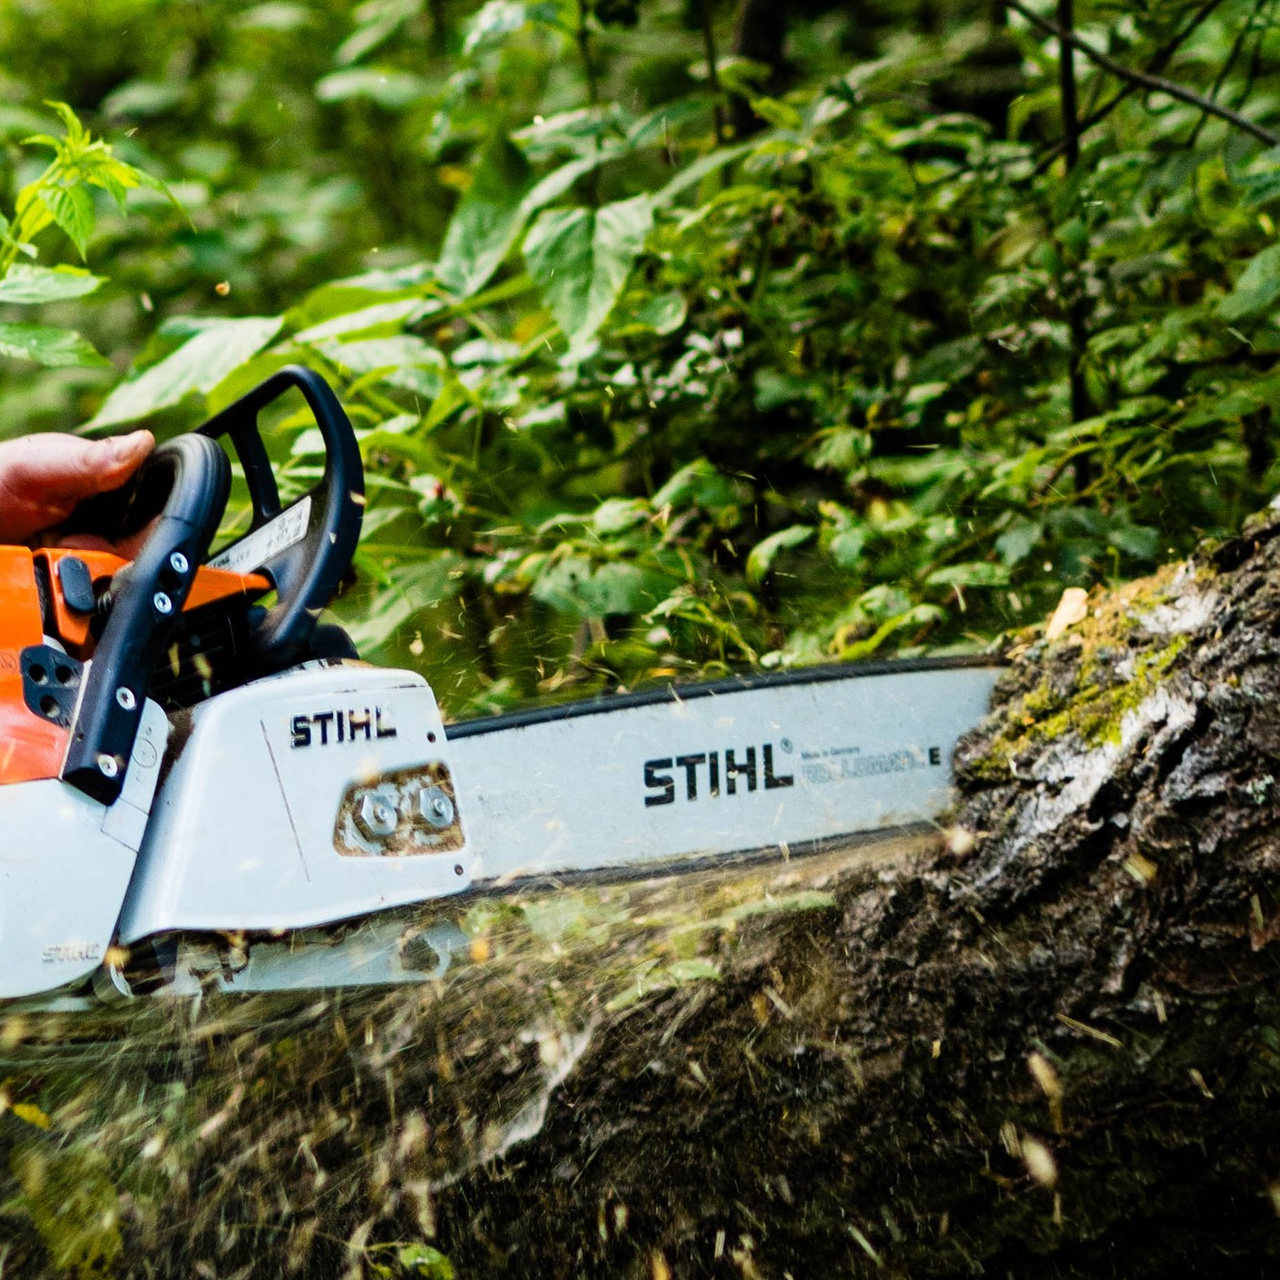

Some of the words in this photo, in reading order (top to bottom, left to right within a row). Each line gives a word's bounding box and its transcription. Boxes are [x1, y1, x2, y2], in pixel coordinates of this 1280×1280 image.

[291, 706, 397, 749] STIHL
[643, 744, 795, 808] STIHL
[928, 746, 942, 766] E
